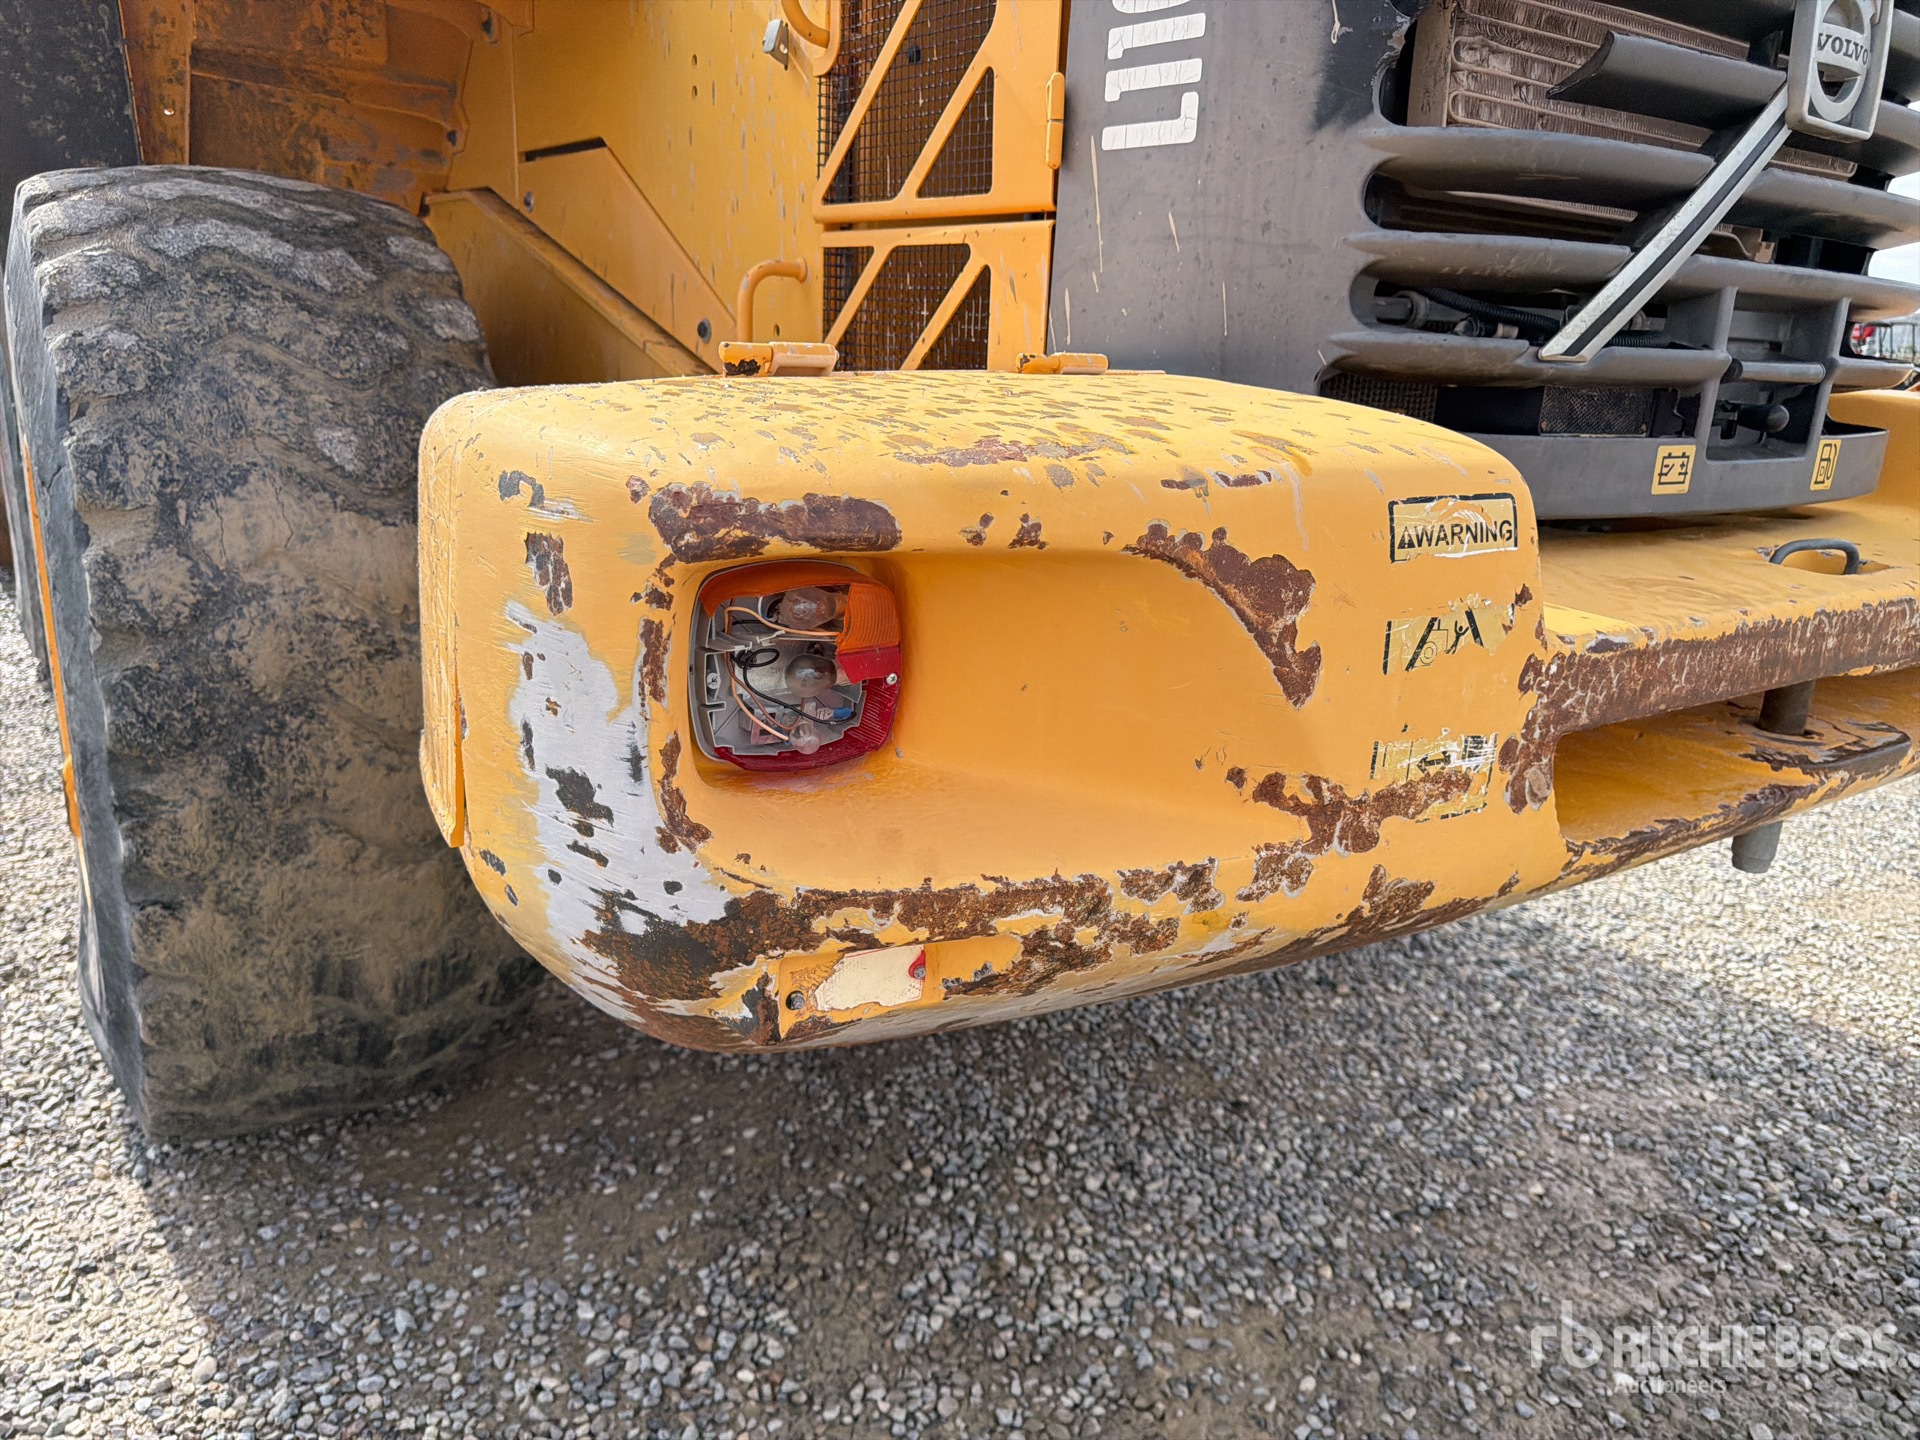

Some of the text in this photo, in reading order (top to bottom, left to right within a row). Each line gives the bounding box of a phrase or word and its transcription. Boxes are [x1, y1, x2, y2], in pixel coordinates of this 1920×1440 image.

[1816, 32, 1869, 66] VOLVO
[1101, 0, 1207, 151] L11
[1414, 519, 1513, 549] WARNING
